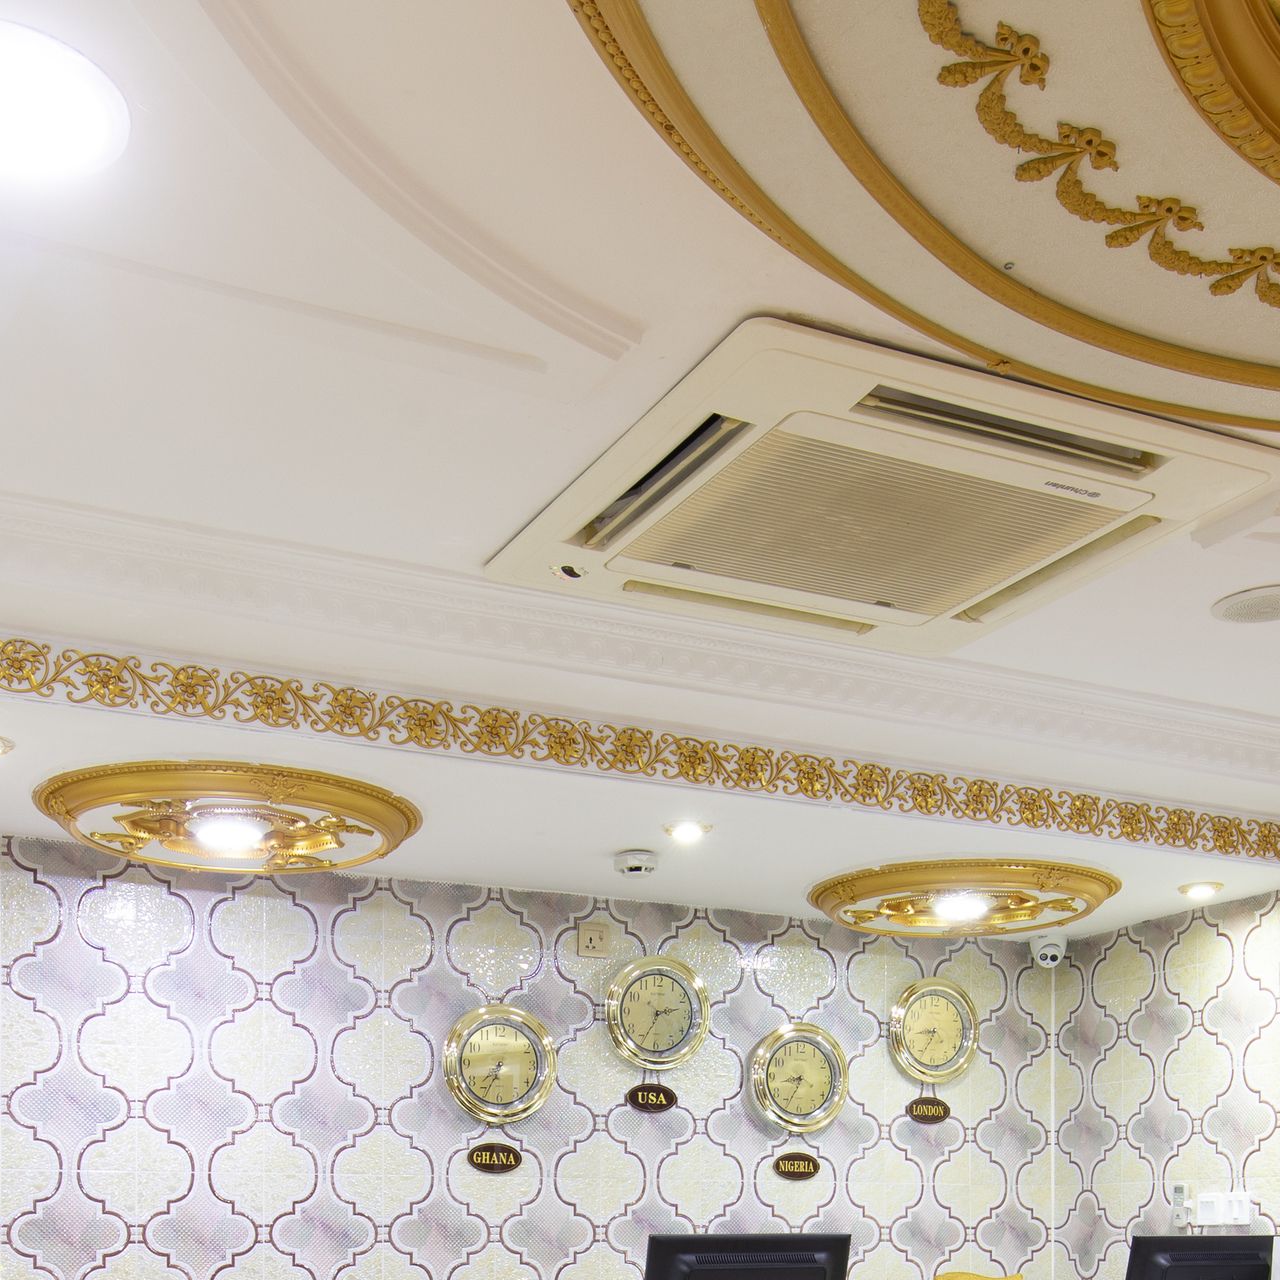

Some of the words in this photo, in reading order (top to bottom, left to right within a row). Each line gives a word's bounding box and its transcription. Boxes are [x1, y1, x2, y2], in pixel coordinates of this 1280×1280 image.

[638, 1092, 666, 1104] USA
[912, 1104, 944, 1116] LONDON
[473, 1152, 515, 1164] GHANA
[779, 1160, 814, 1172] NIGERIA
